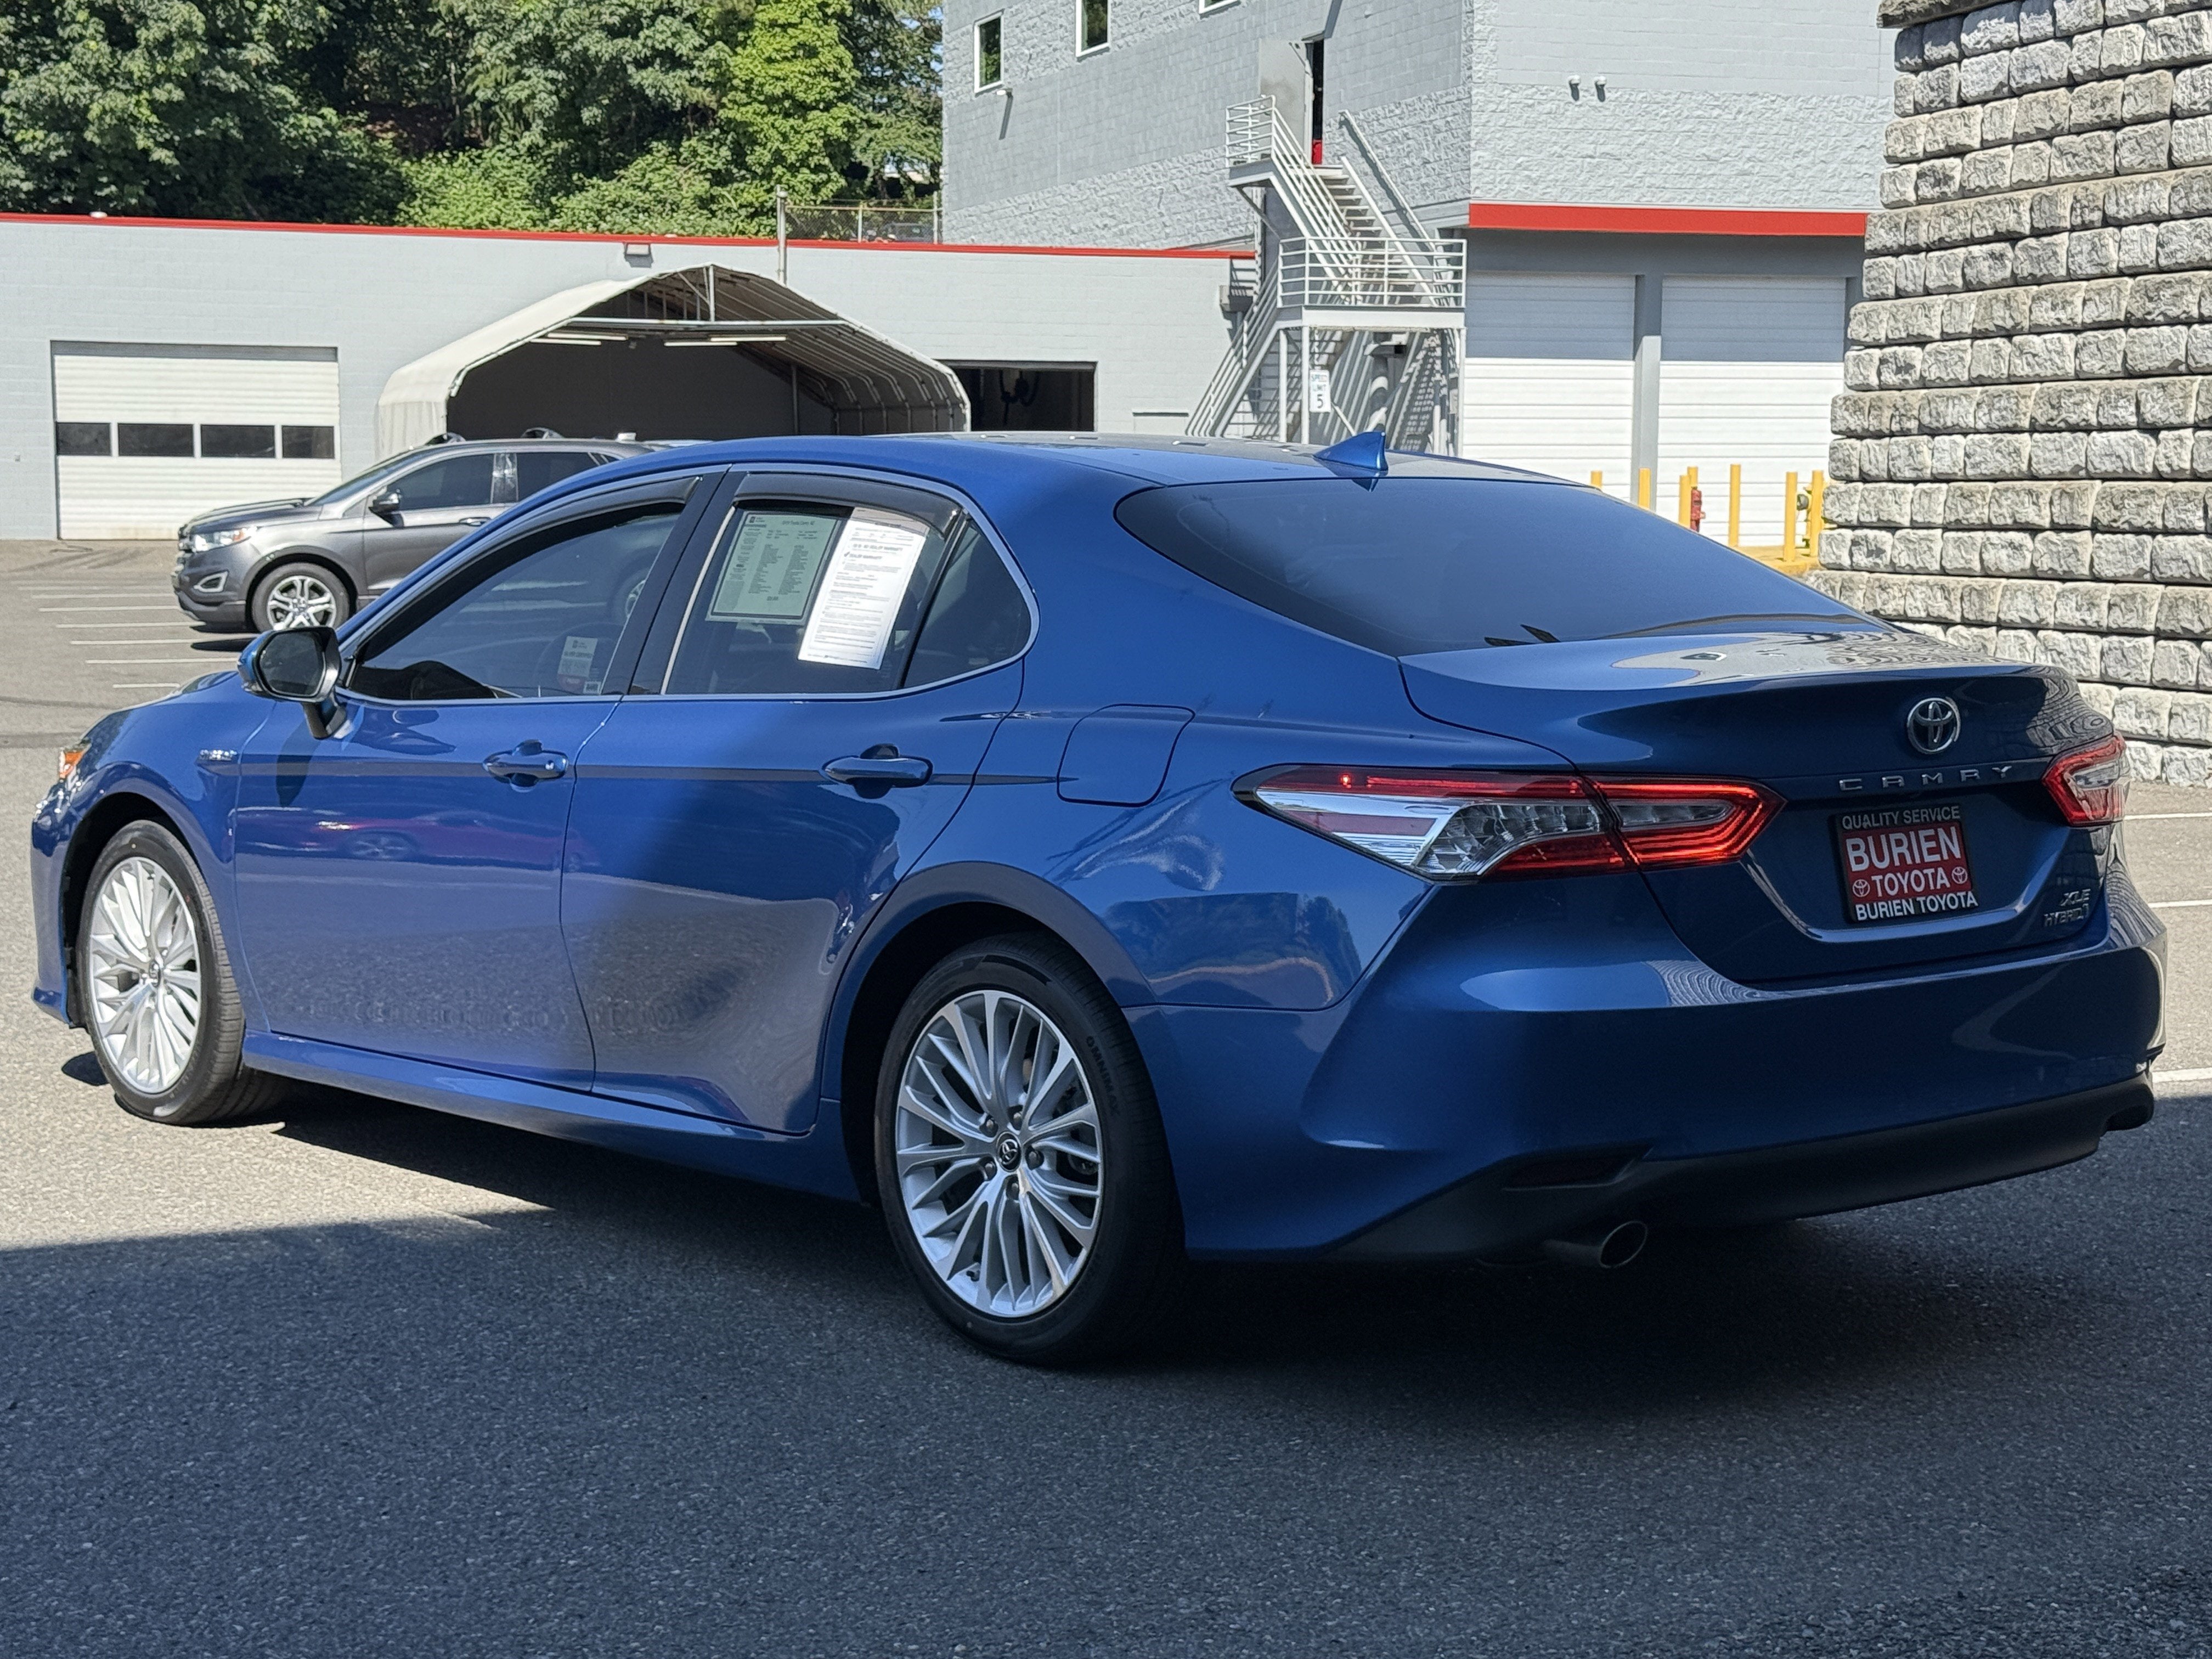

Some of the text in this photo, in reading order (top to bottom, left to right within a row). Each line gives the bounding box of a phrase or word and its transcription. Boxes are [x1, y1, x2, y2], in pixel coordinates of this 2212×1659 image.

[1317, 394, 1324, 409] 5
[1839, 765, 2012, 791] CAMRY
[1842, 806, 1961, 830] QUALITY SERVICE
[1846, 826, 1961, 872] BURIEN
[1871, 867, 1950, 897] TOYOTA
[1855, 890, 1979, 921] BURIEN TOYOTA
[2060, 888, 2091, 907] XLE
[2044, 903, 2089, 927] HYBRID
